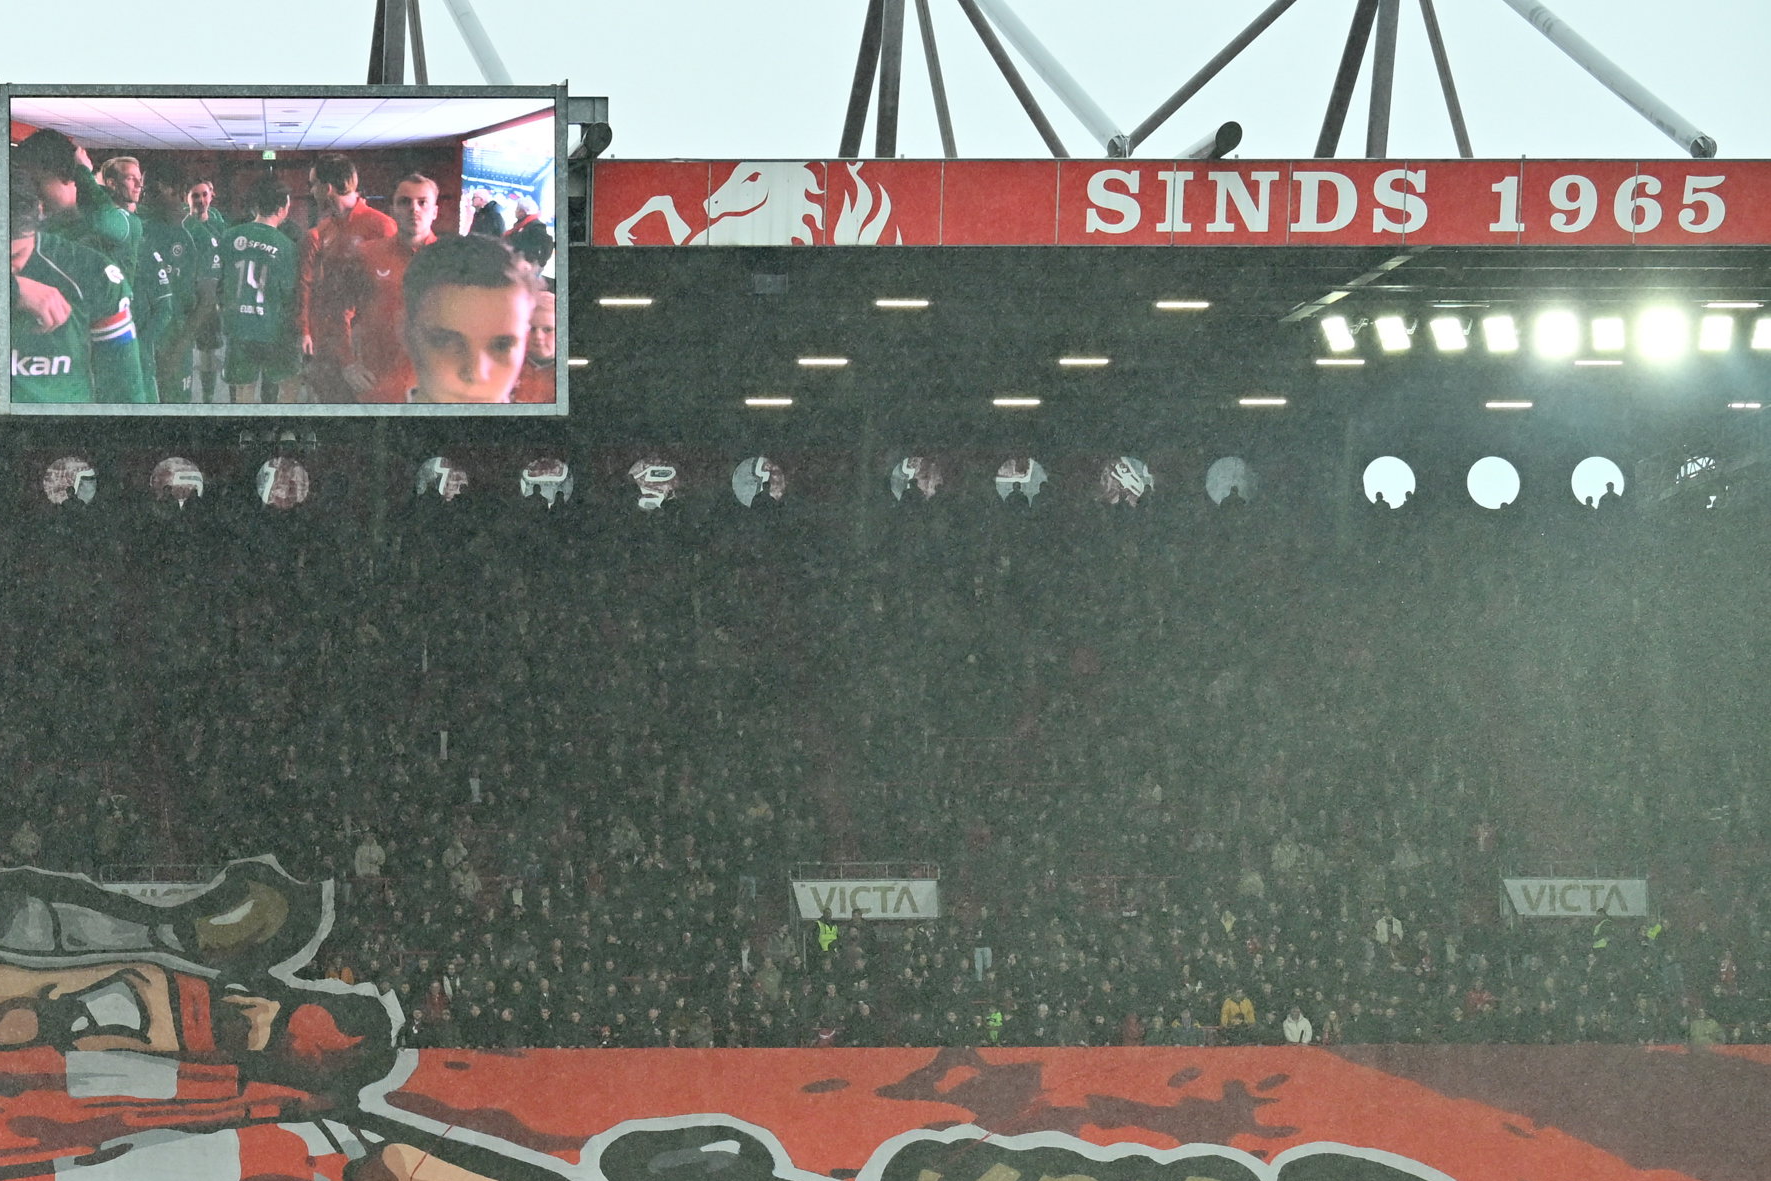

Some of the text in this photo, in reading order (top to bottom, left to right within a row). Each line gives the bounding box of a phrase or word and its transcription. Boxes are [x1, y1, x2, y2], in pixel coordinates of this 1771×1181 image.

[1085, 168, 1727, 236] SINDS 1965
[248, 240, 279, 255] SPORT
[234, 260, 268, 304] 14
[11, 349, 72, 377] kan
[808, 886, 919, 914] VICTA
[1521, 884, 1628, 912] VICTA
